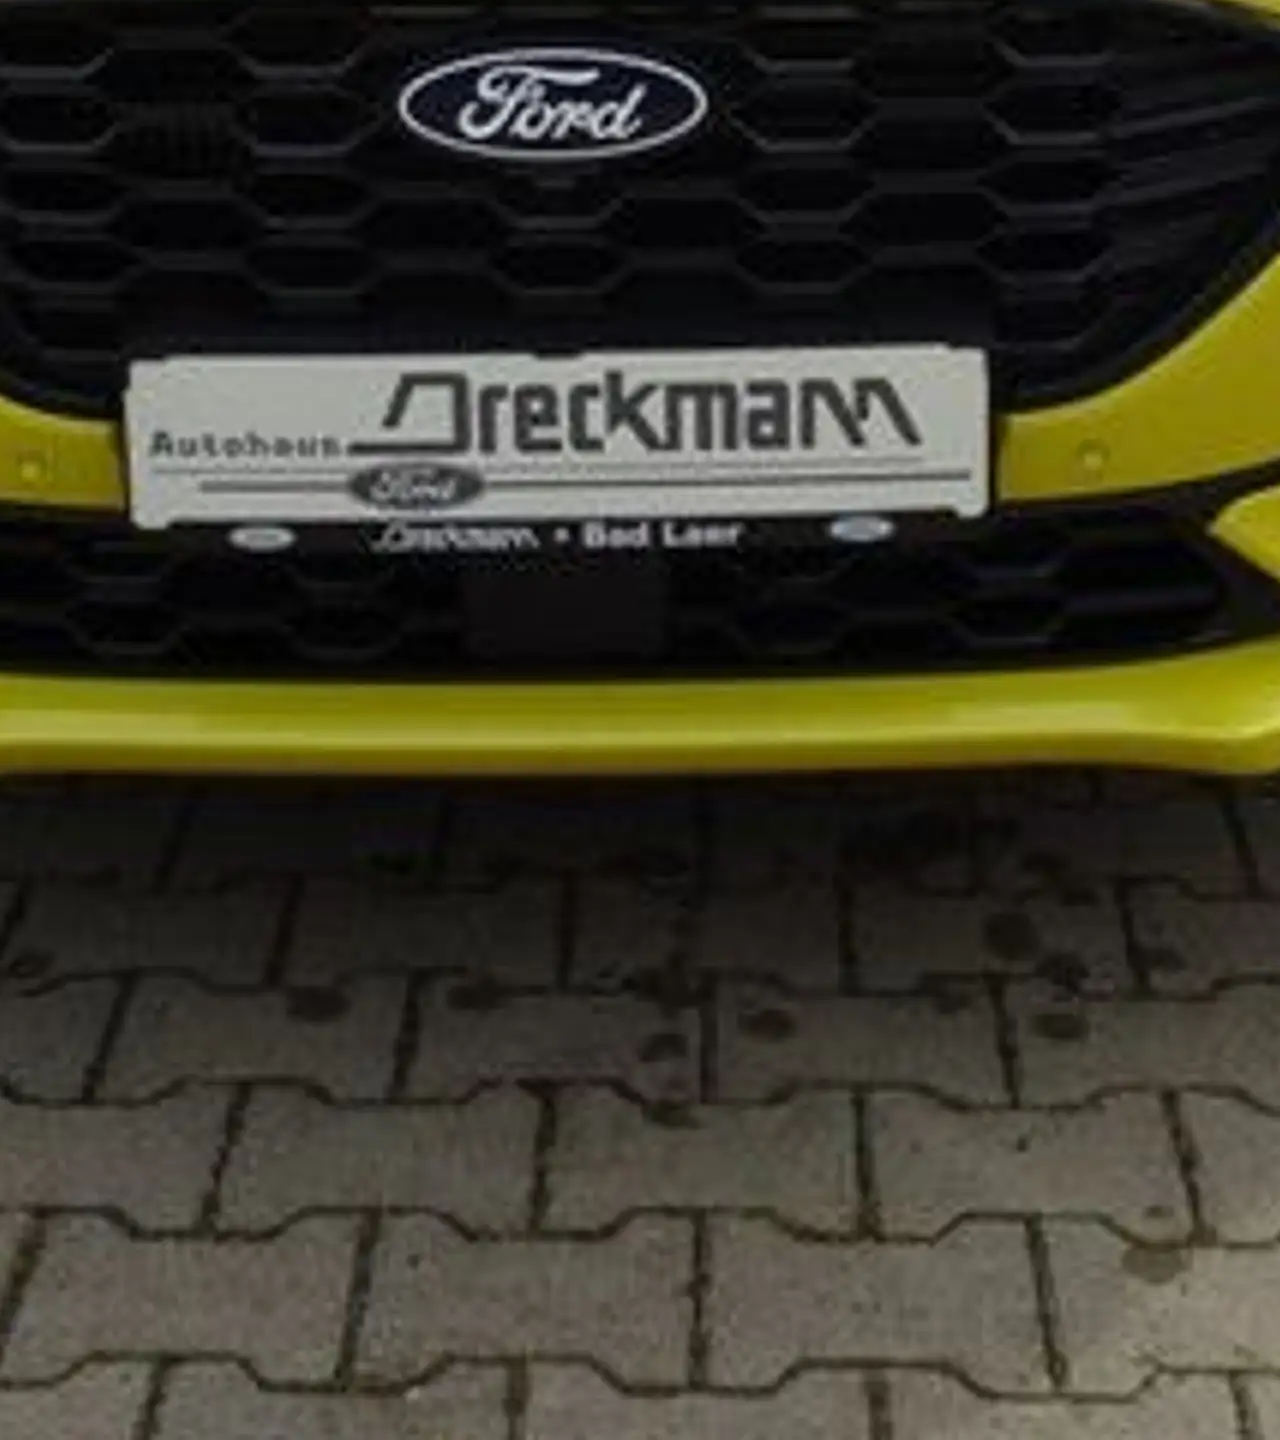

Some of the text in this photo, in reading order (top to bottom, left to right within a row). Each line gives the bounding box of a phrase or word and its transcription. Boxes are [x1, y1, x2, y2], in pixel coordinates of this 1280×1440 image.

[458, 65, 647, 140] Ford
[149, 370, 922, 459] Autohaus Dreckmann
[583, 522, 650, 549] Bad
